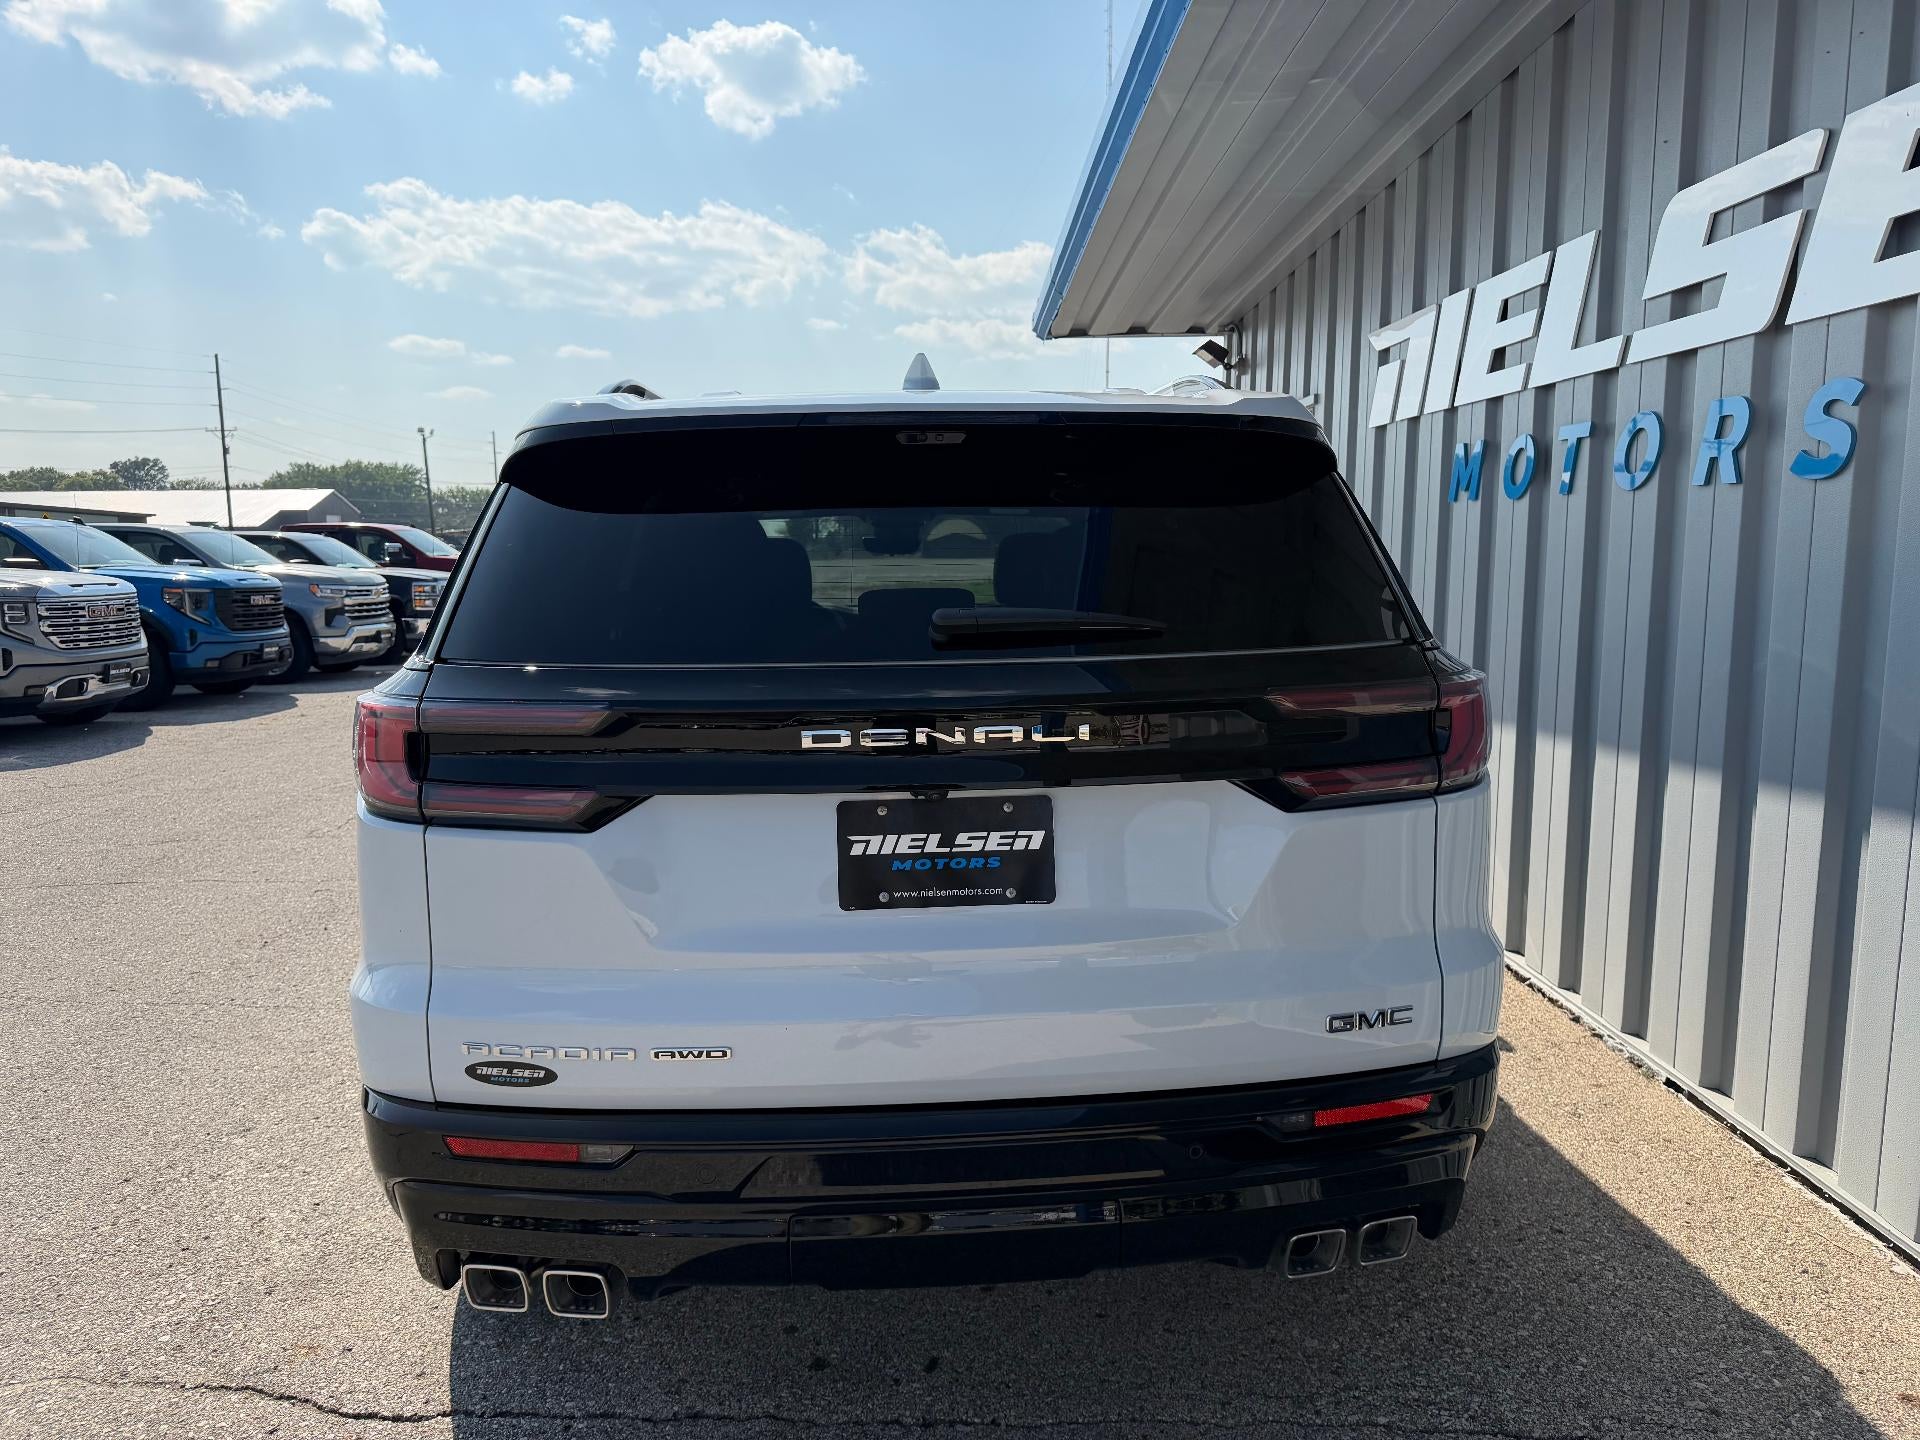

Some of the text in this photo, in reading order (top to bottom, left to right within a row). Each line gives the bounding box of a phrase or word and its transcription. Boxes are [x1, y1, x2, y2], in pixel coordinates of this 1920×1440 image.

[1449, 376, 1866, 502] MOTORS
[89, 604, 125, 618] GMC
[800, 723, 1090, 749] DENALI
[847, 830, 1046, 856] NIELSEN
[891, 856, 1002, 872] MOTORS
[893, 886, 1004, 899] www.nielsenmotors.com
[1326, 1004, 1414, 1034] GMC
[461, 1041, 730, 1061] ACADIA AWD
[475, 1066, 546, 1078] NIELSEN
[490, 1076, 530, 1084] MOTORS
